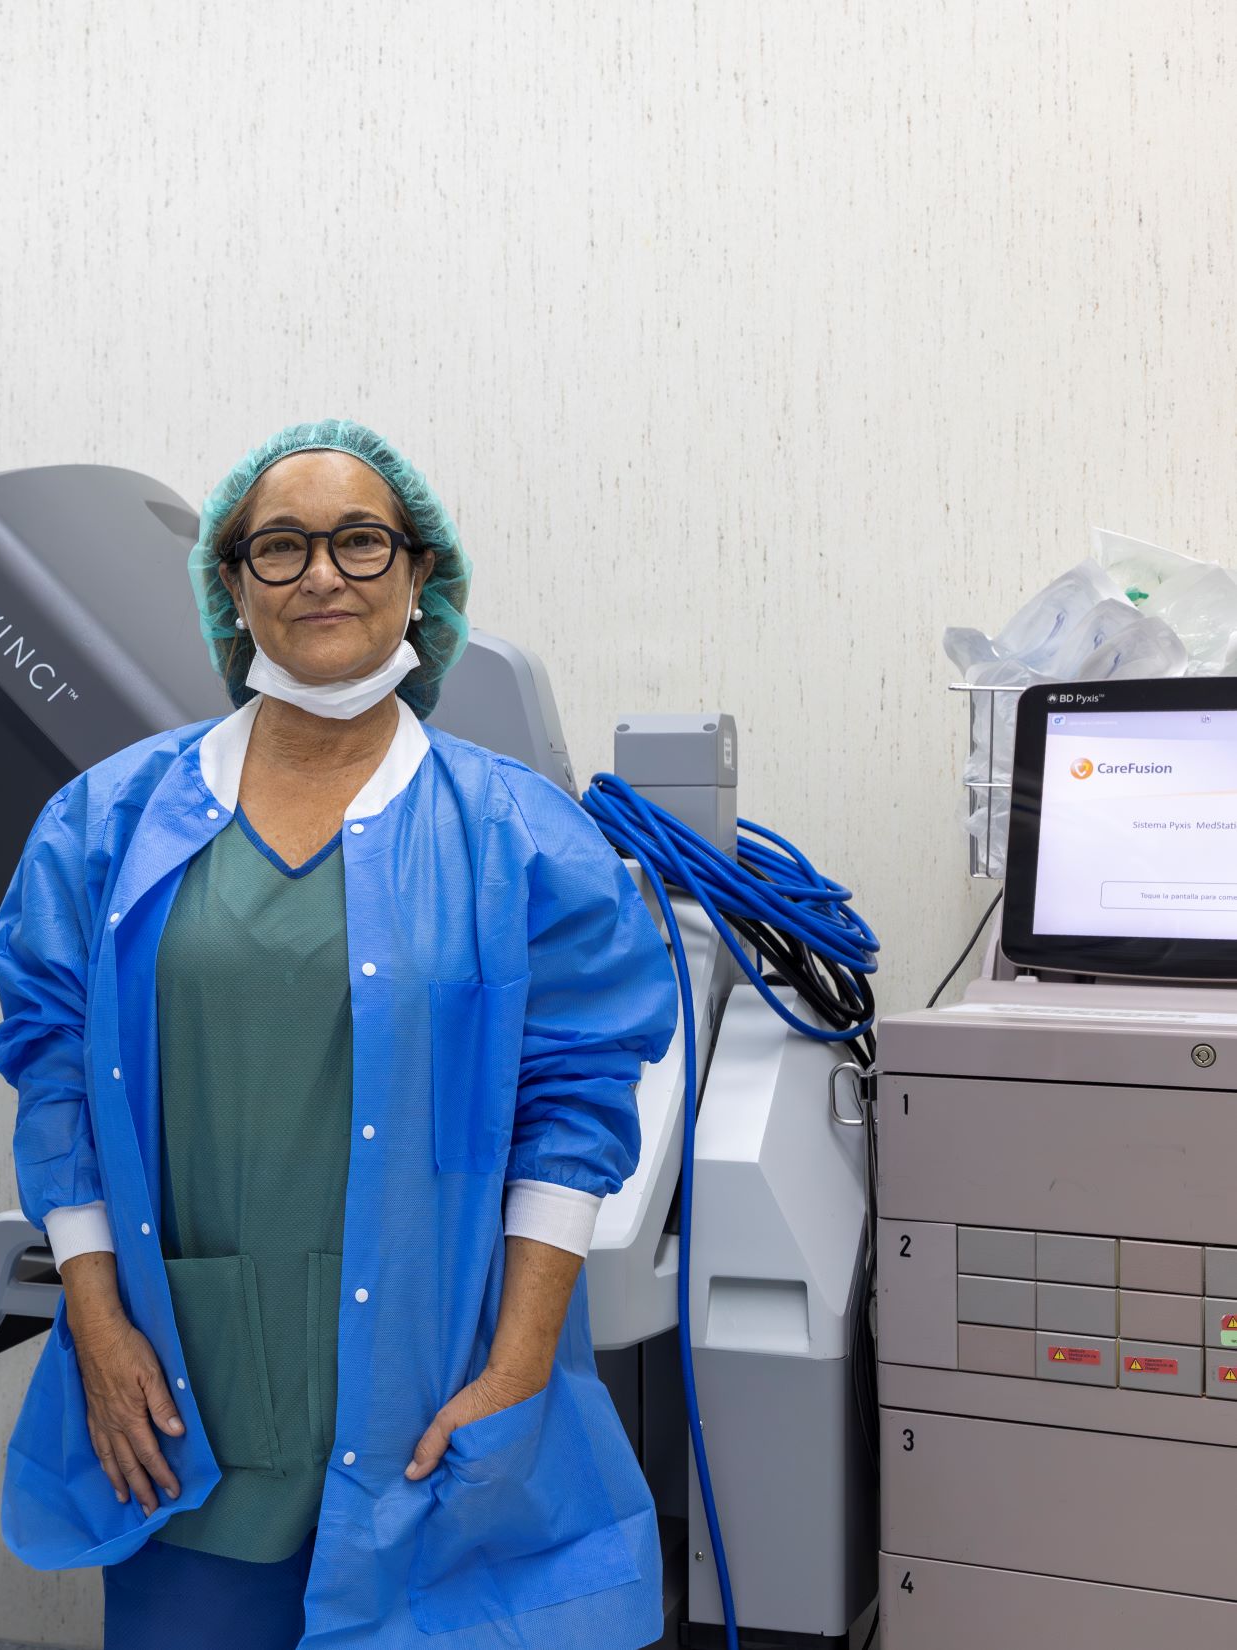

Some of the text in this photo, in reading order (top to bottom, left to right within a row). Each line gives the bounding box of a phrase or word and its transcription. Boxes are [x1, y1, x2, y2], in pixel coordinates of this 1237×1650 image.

[1059, 694, 1073, 703] BD
[1097, 761, 1173, 775] CareFusion
[1132, 821, 1167, 829] Sistema
[1169, 821, 1192, 831] Pyxis
[1141, 892, 1161, 901] Toque
[903, 1093, 909, 1115] 1
[900, 1234, 912, 1258] 2
[902, 1428, 915, 1451] 3
[900, 1571, 914, 1594] 4
